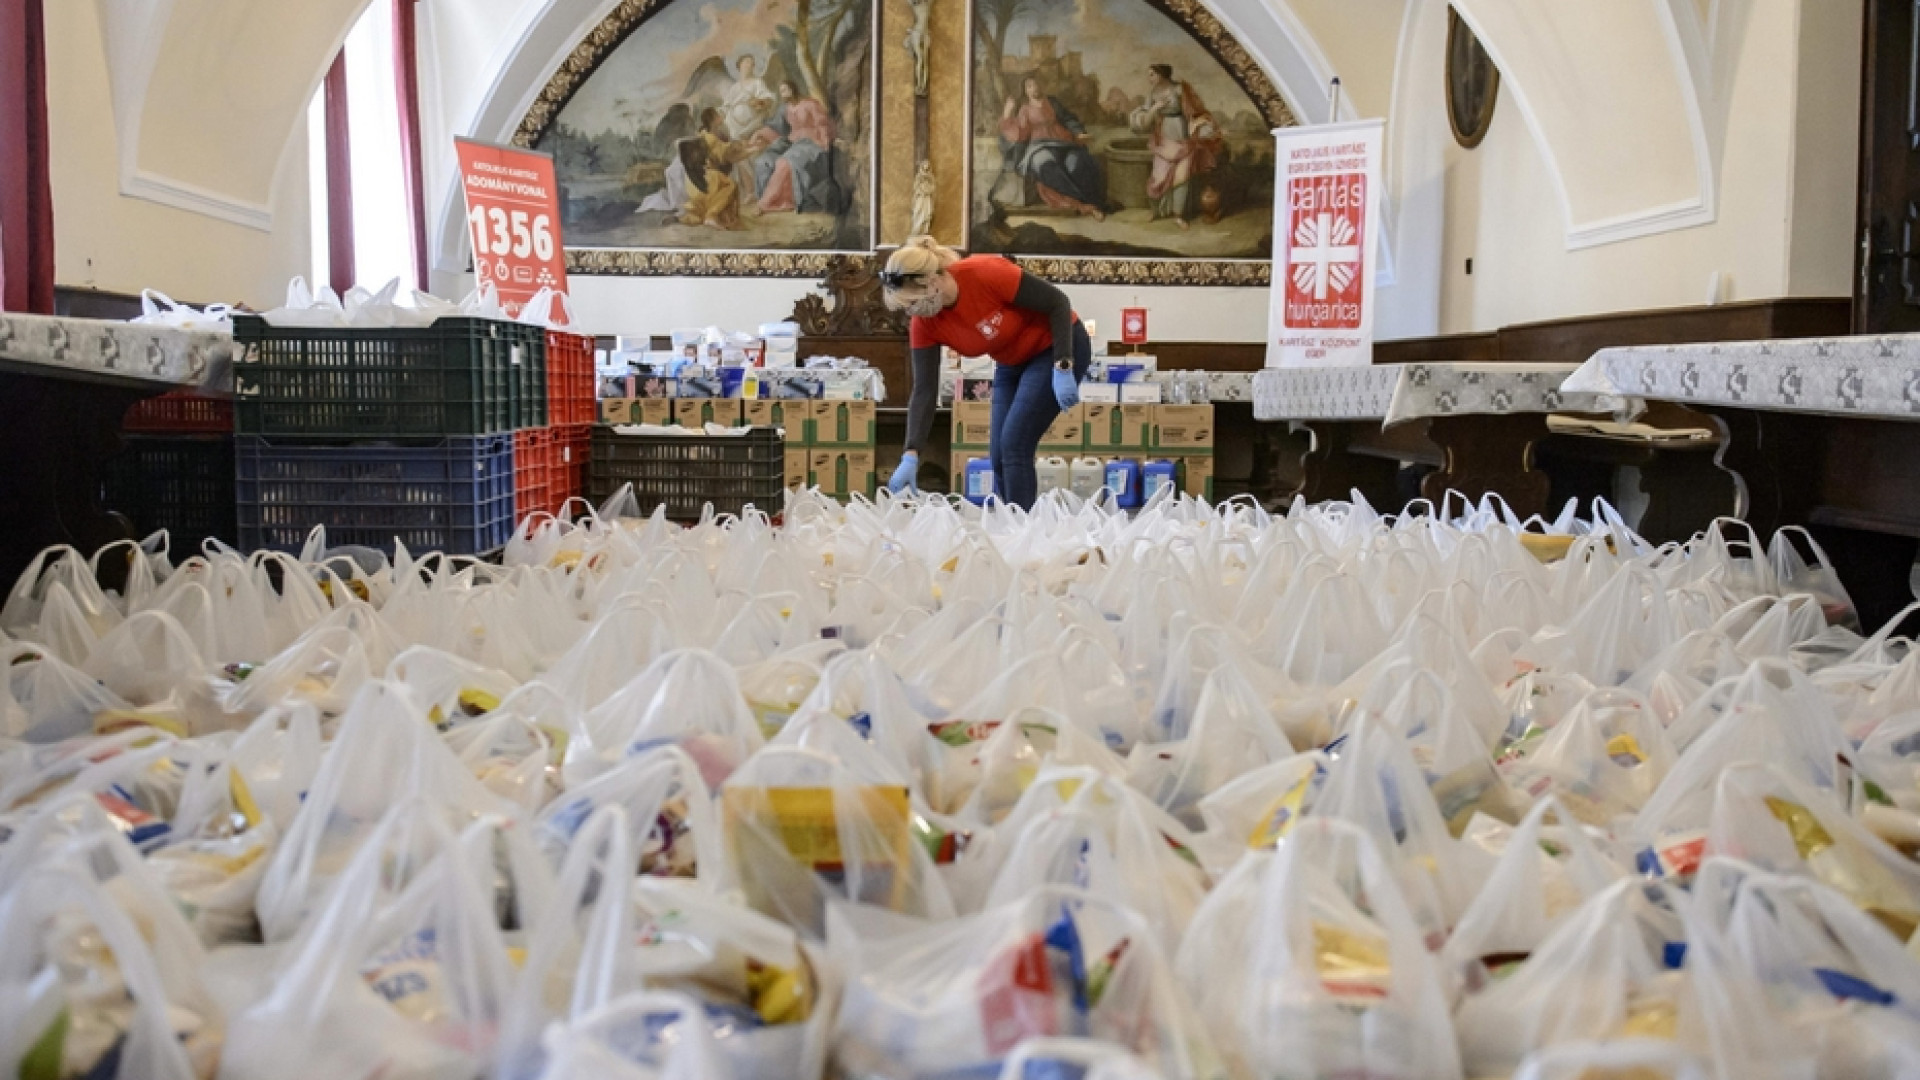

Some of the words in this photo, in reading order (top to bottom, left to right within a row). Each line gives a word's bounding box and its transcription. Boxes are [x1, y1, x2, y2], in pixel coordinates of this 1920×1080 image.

[1291, 178, 1361, 210] caritas
[471, 204, 554, 262] 1356
[1288, 298, 1358, 327] hungarica
